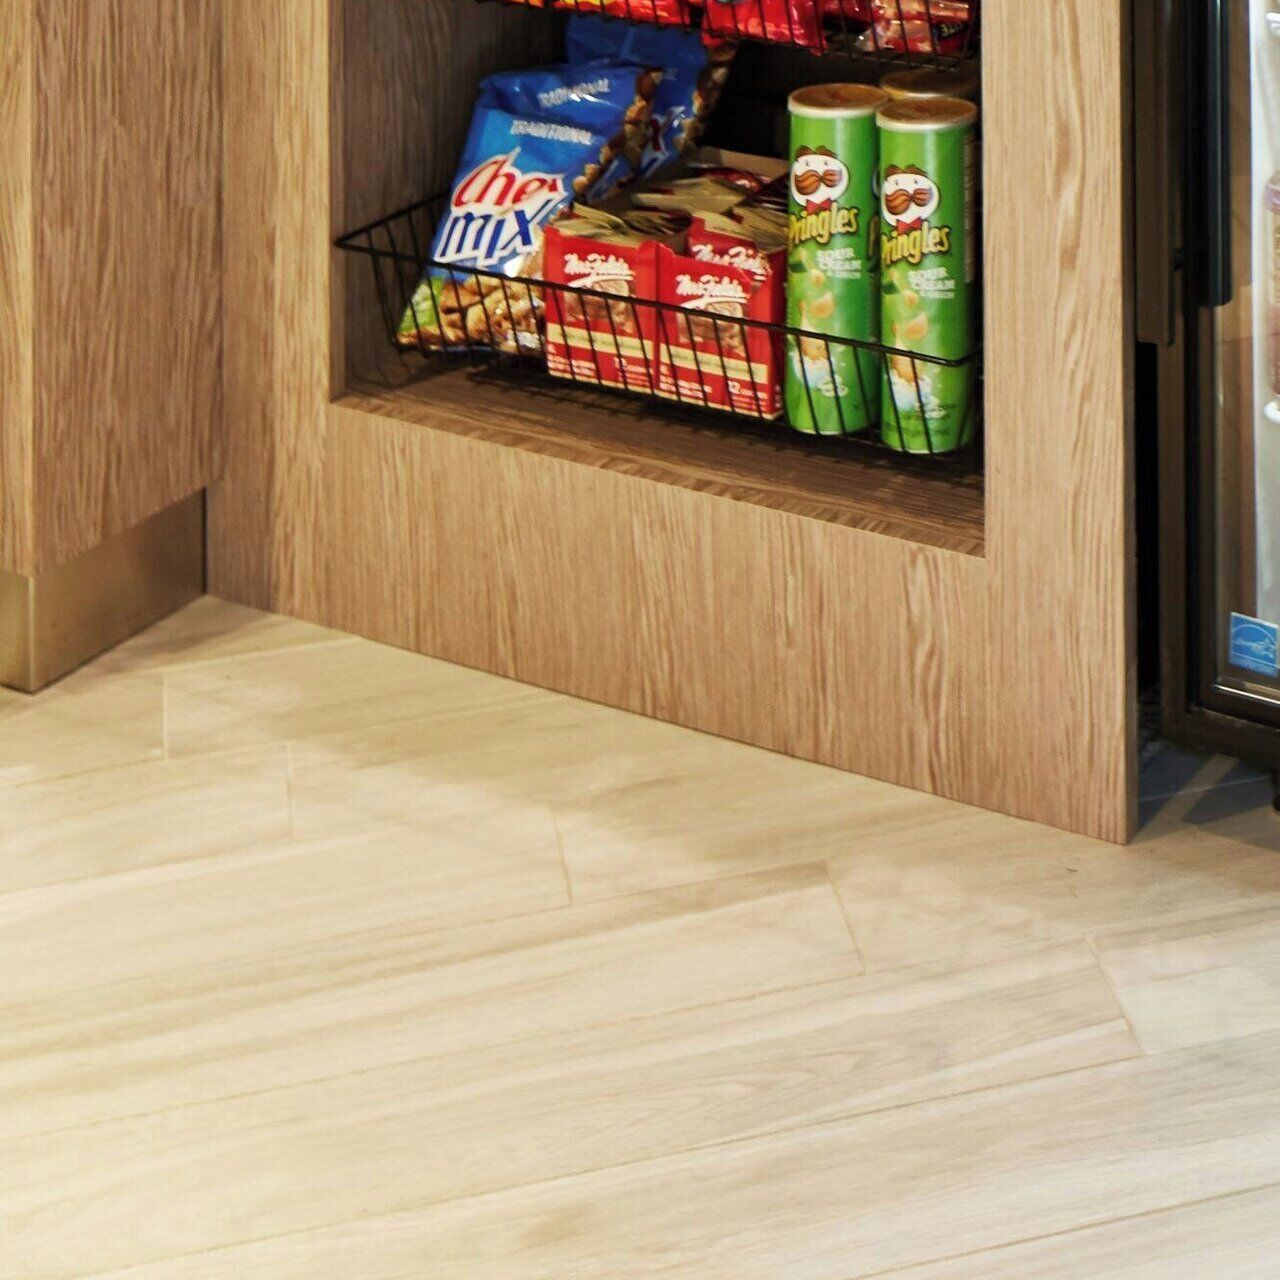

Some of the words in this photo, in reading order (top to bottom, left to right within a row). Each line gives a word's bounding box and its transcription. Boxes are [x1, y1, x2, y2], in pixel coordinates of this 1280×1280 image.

[510, 119, 593, 145] TRADITIONAL
[816, 247, 855, 260] SOUR
[907, 267, 948, 280] SOUR
